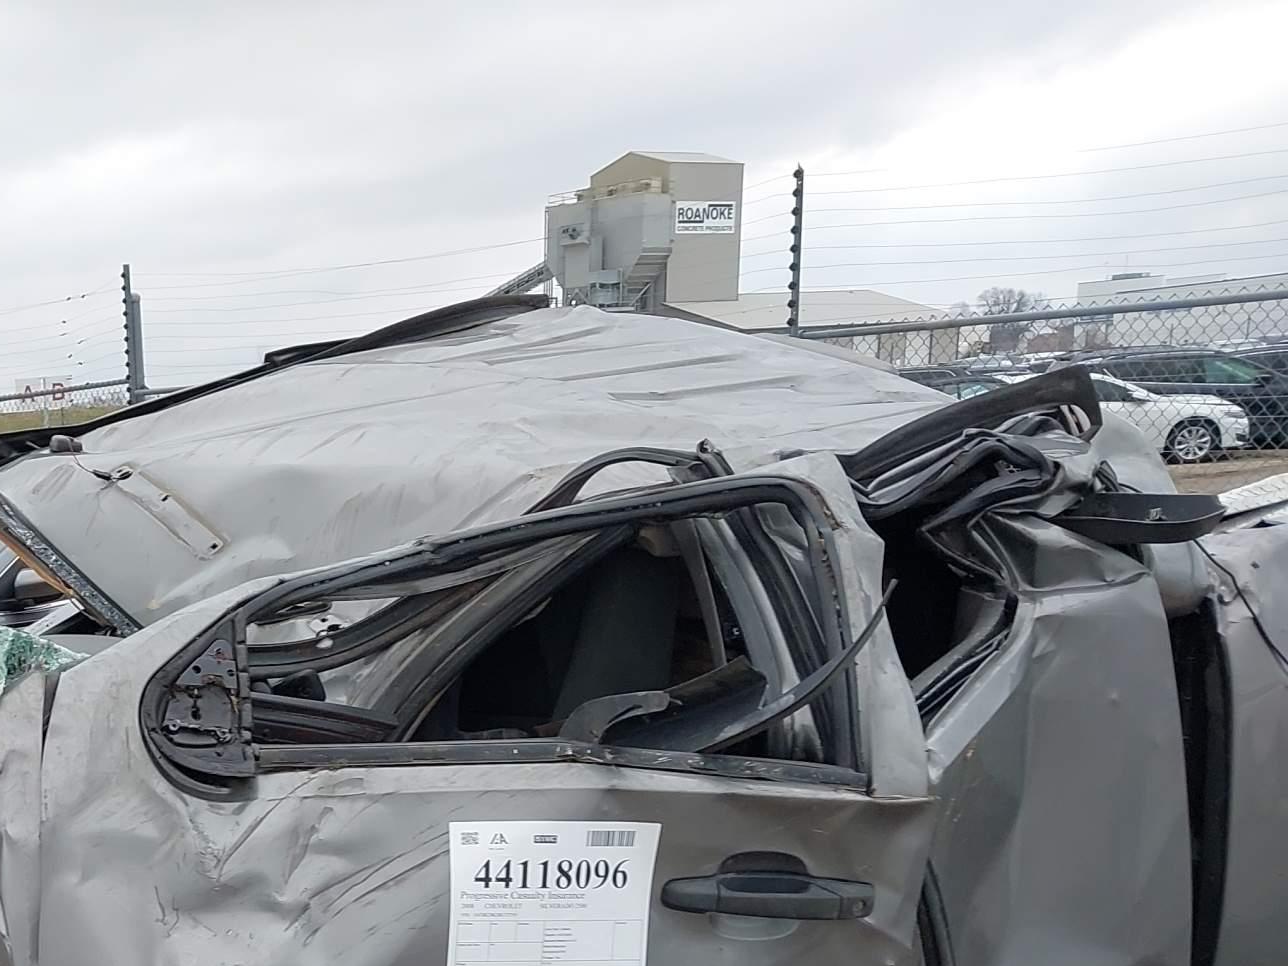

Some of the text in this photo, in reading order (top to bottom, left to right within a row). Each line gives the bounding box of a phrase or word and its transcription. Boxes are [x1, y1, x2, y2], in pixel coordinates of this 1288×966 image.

[677, 207, 733, 220] ROANOKE
[22, 385, 35, 403] A
[474, 859, 630, 889] 44118096
[460, 890, 585, 901] Progressive Casualty Insurance
